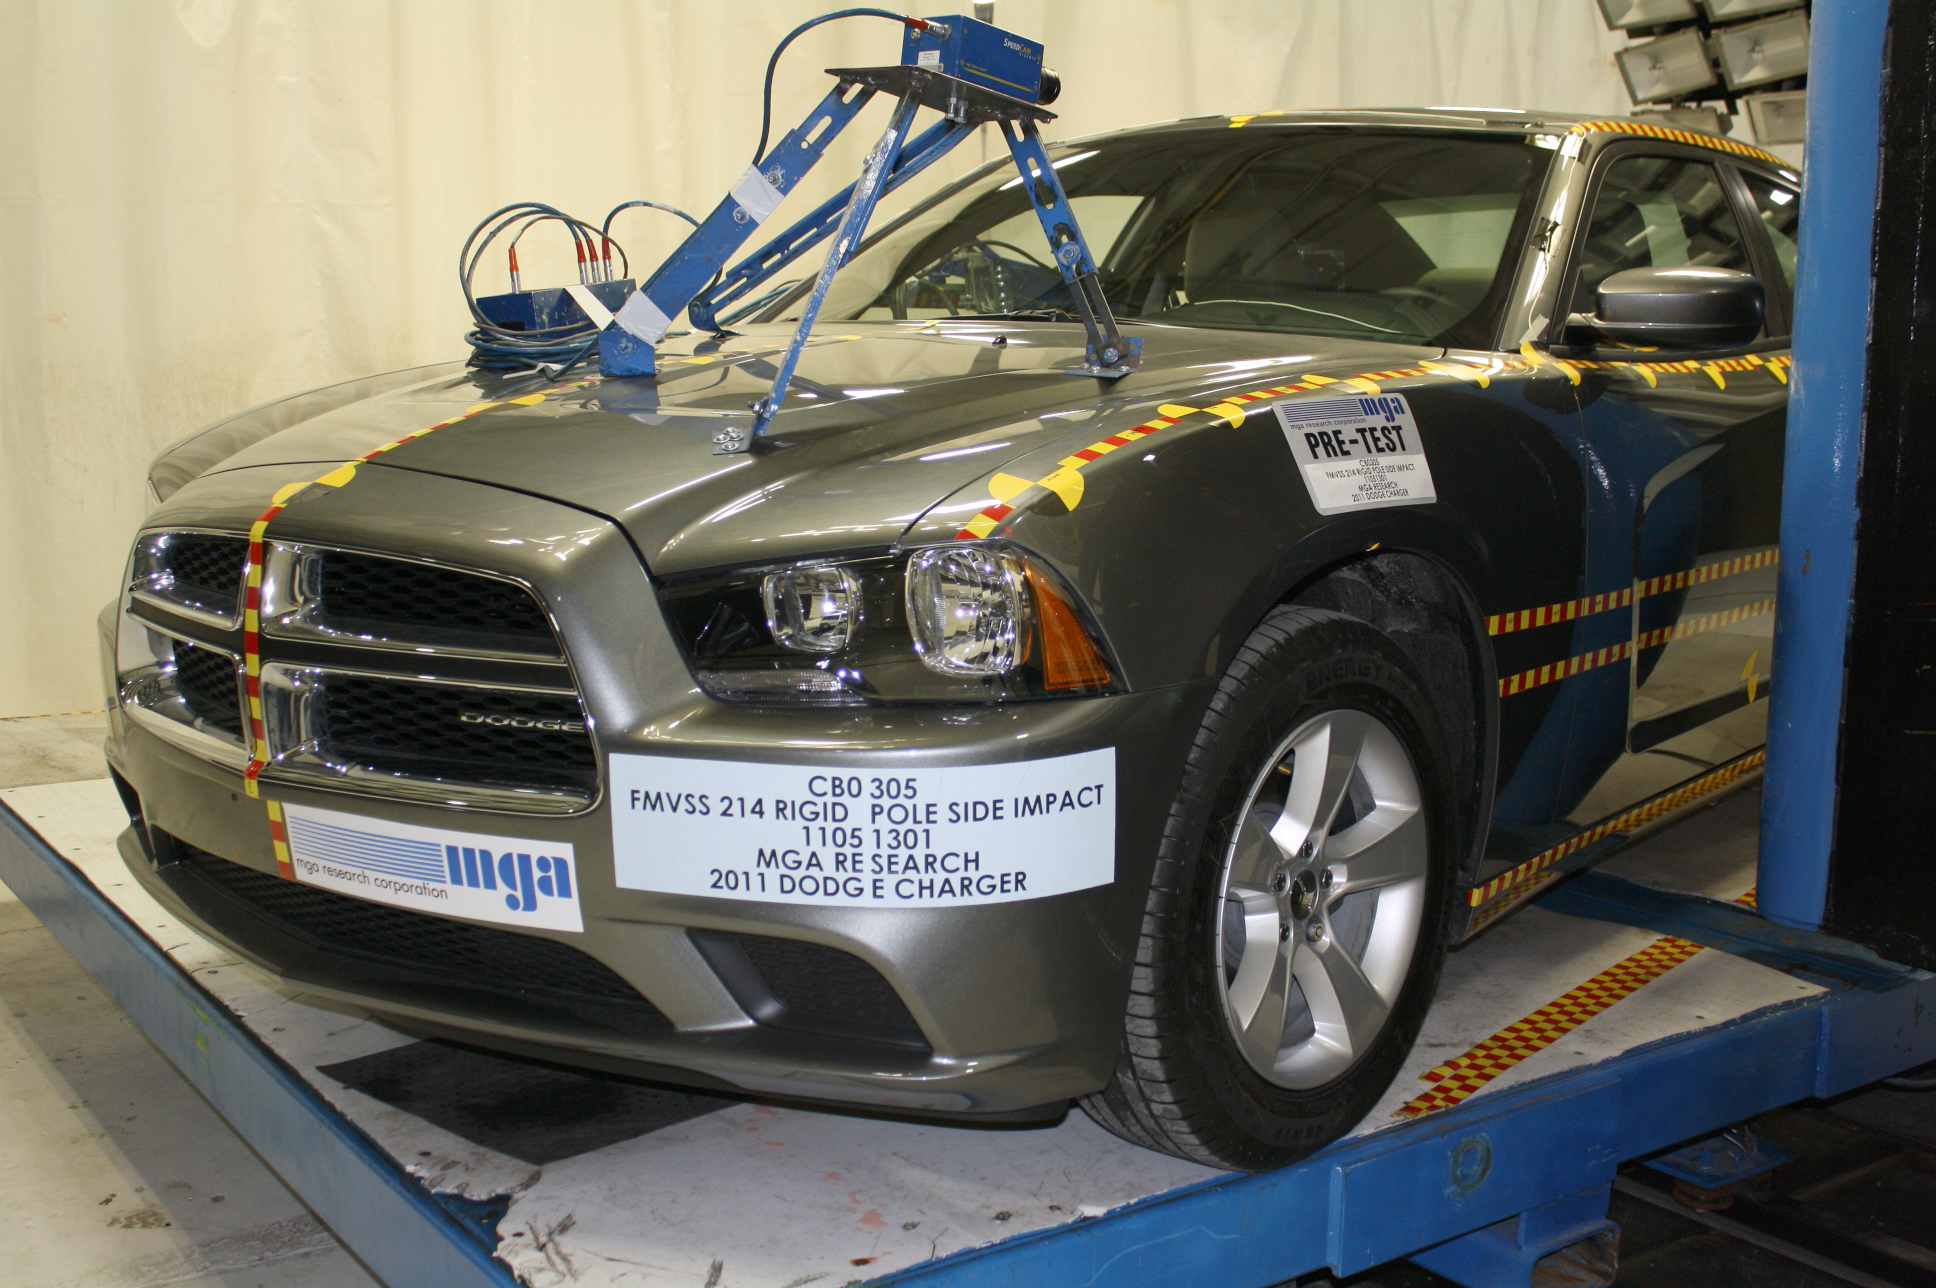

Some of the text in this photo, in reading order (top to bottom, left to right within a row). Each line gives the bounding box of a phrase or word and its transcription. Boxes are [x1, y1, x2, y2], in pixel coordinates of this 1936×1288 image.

[1359, 396, 1406, 423] mga
[1290, 417, 1367, 431] mga research corporation
[1303, 425, 1407, 460] PRE-TEST
[1325, 463, 1416, 479] FMVSS 214 RIGID POLE SIDE IMPACT
[1351, 488, 1409, 502] 2011 DODGE CHARGER
[1358, 481, 1399, 493] MGA RESEARCH
[460, 712, 585, 732] DODGE
[630, 783, 1105, 826] FMVSS 214 RIGID POLE SIDE IMPACT
[756, 848, 825, 873] MGA
[296, 857, 448, 900] mga research corporation
[445, 844, 573, 912] mga
[709, 868, 767, 894] 2011
[894, 871, 1028, 900] CHARGER
